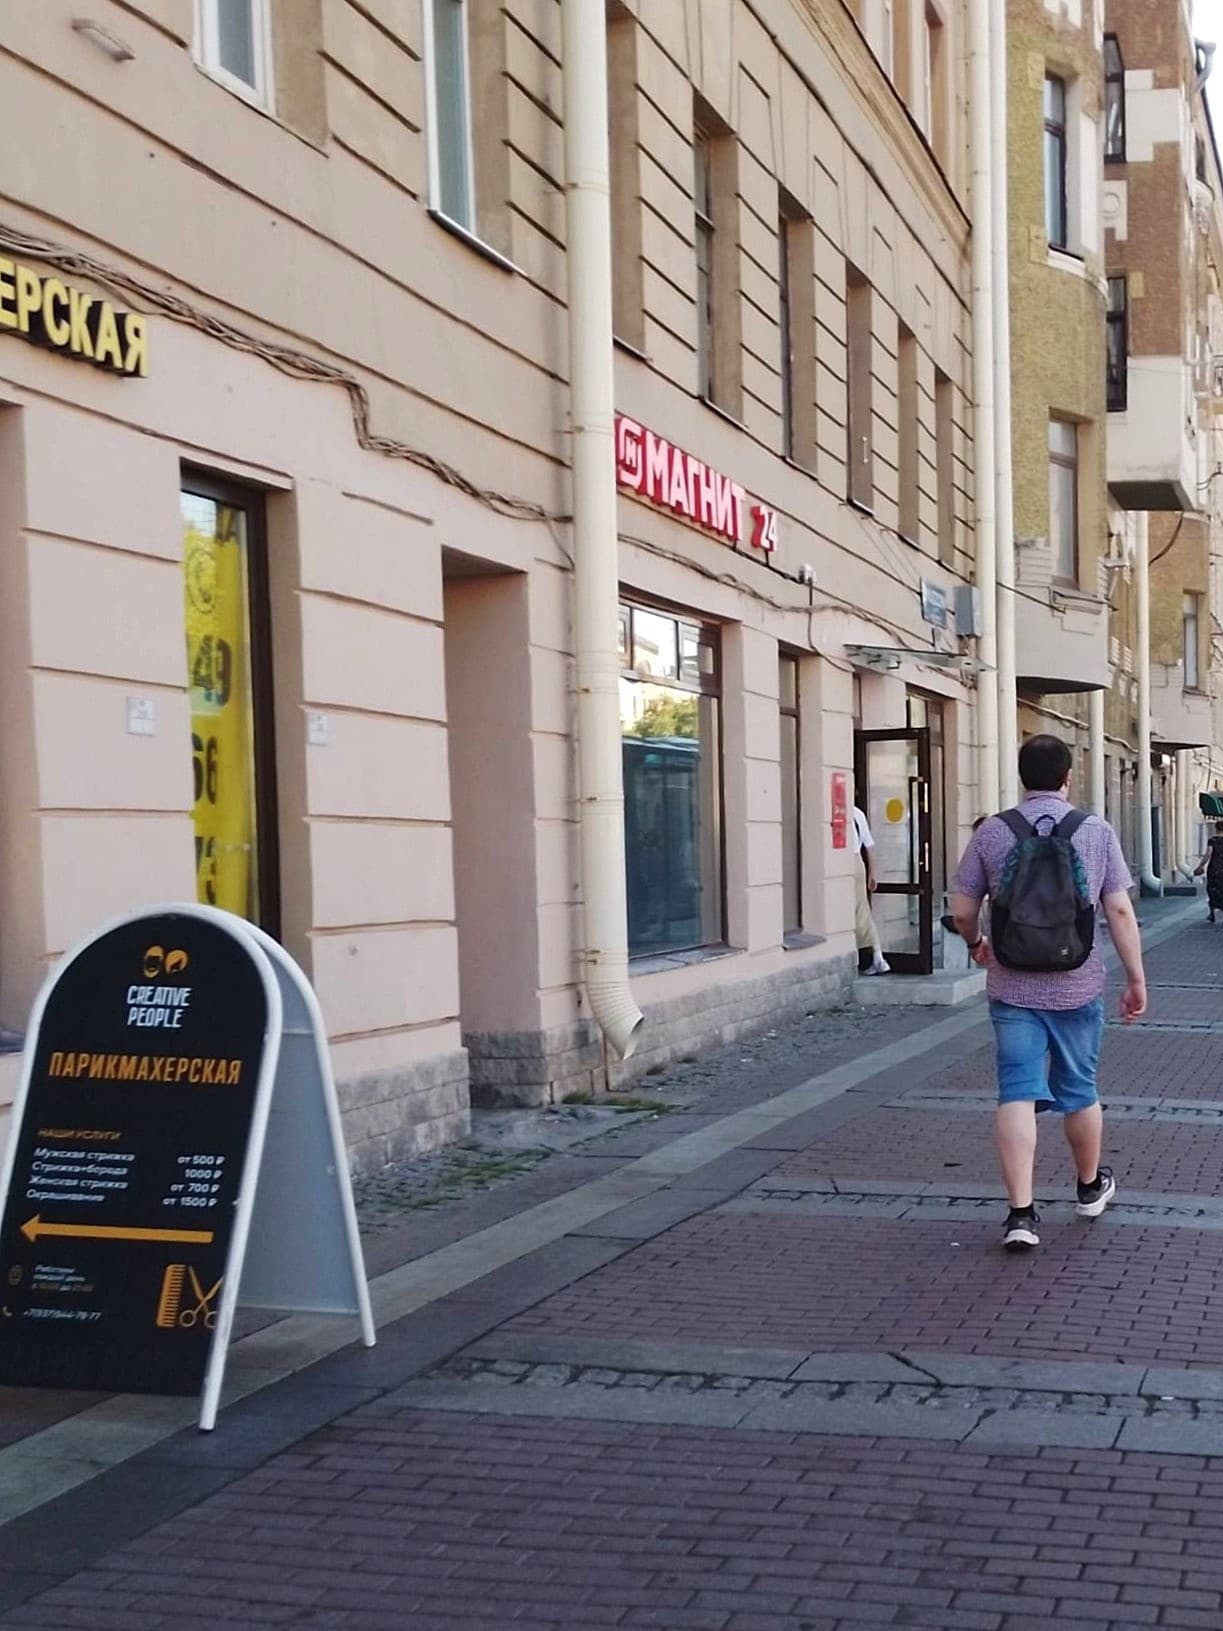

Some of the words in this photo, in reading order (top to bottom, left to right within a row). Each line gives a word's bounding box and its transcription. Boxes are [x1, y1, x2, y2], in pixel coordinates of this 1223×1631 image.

[645, 429, 746, 541] МАГНИТ
[756, 504, 778, 551] 24
[127, 985, 192, 1006] CREATIVE
[127, 1007, 184, 1028] PEOPLE
[49, 1052, 242, 1084] ПАРИКМАХЕРСКАЯ
[193, 1154, 214, 1165] 500
[185, 1168, 212, 1179] 1000
[188, 1182, 209, 1193] 700
[181, 1196, 207, 1207] 1500
